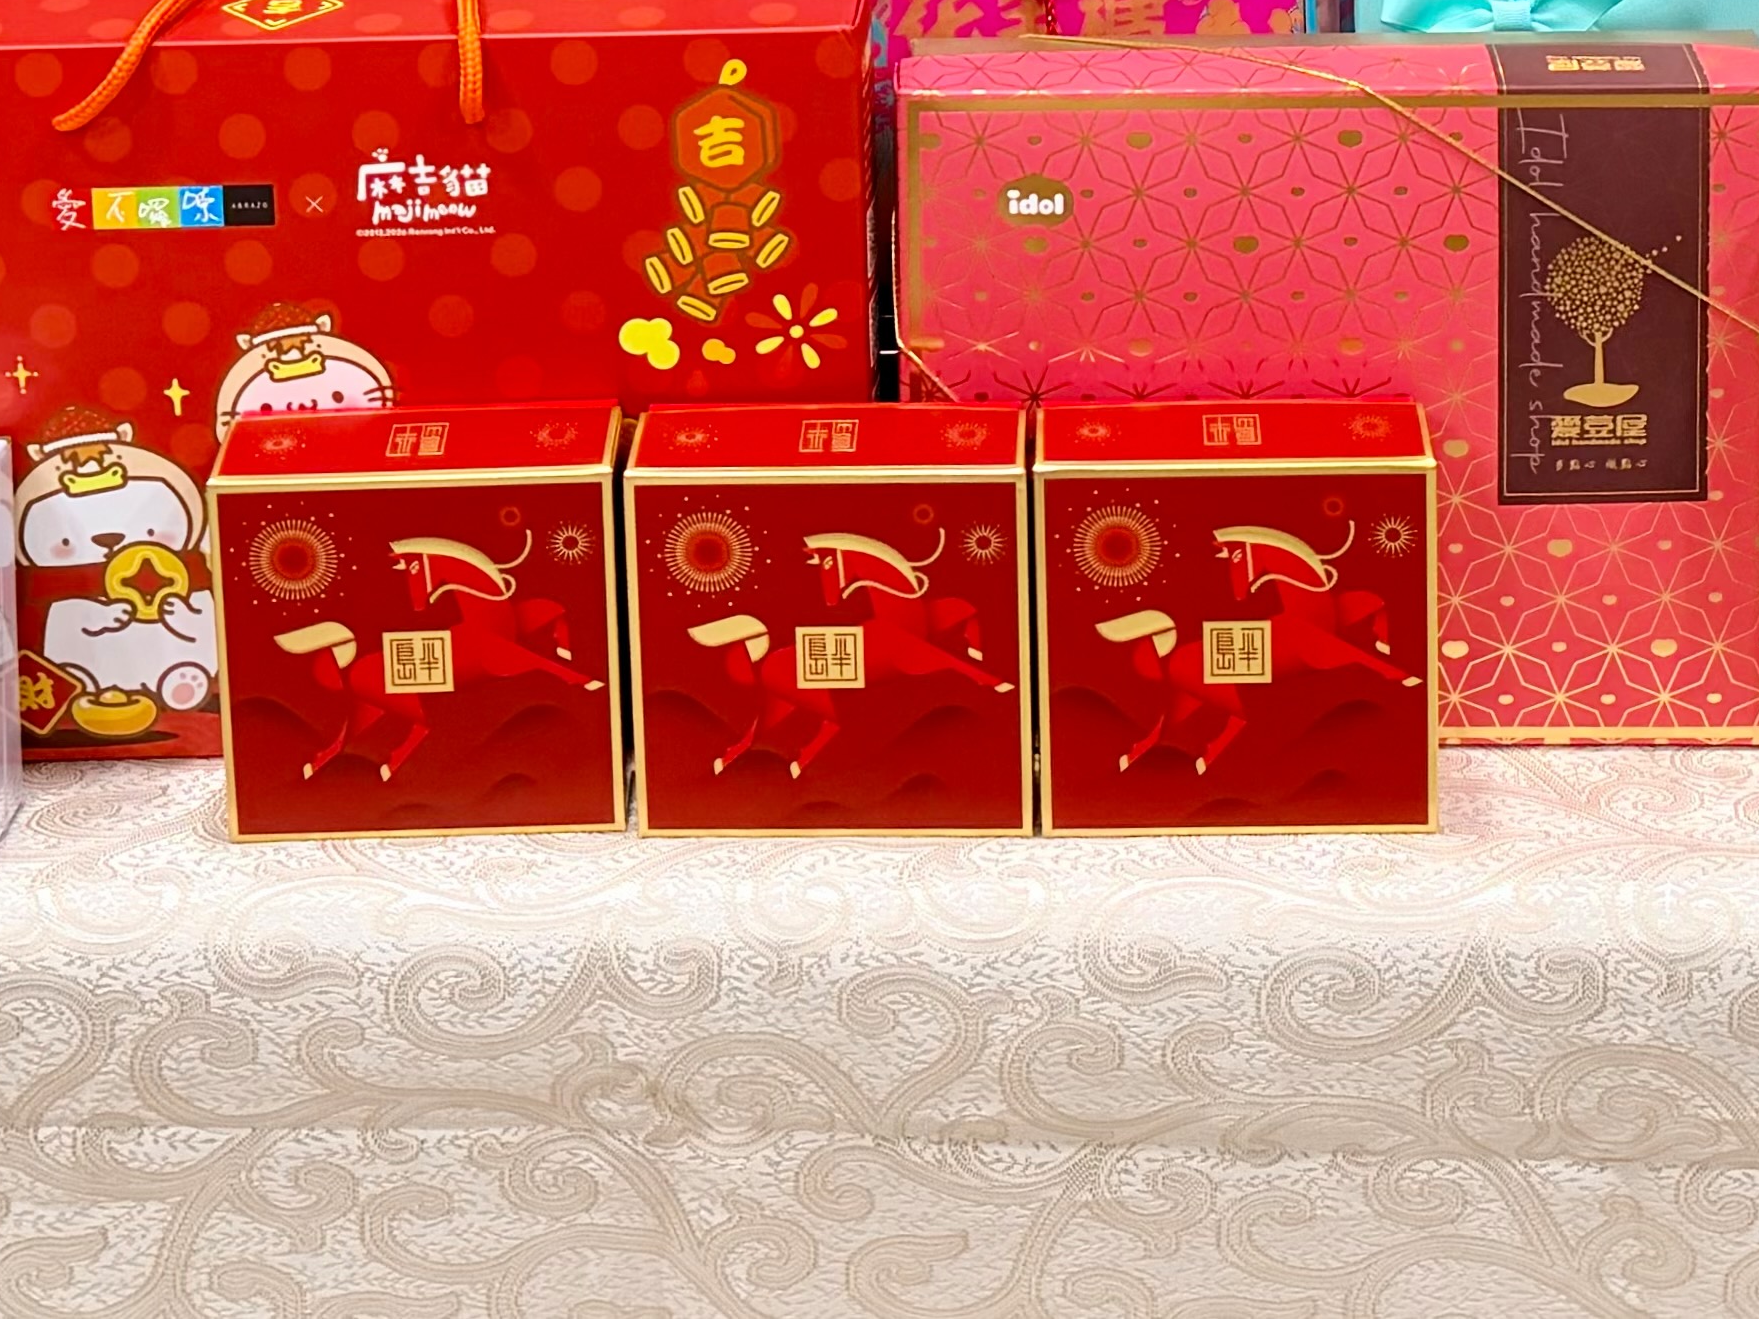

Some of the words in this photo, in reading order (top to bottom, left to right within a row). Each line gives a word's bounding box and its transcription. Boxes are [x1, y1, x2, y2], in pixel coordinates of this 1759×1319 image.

[694, 115, 745, 168] 吉
[357, 153, 492, 203] 麻吉貓
[1006, 189, 1066, 219] idol
